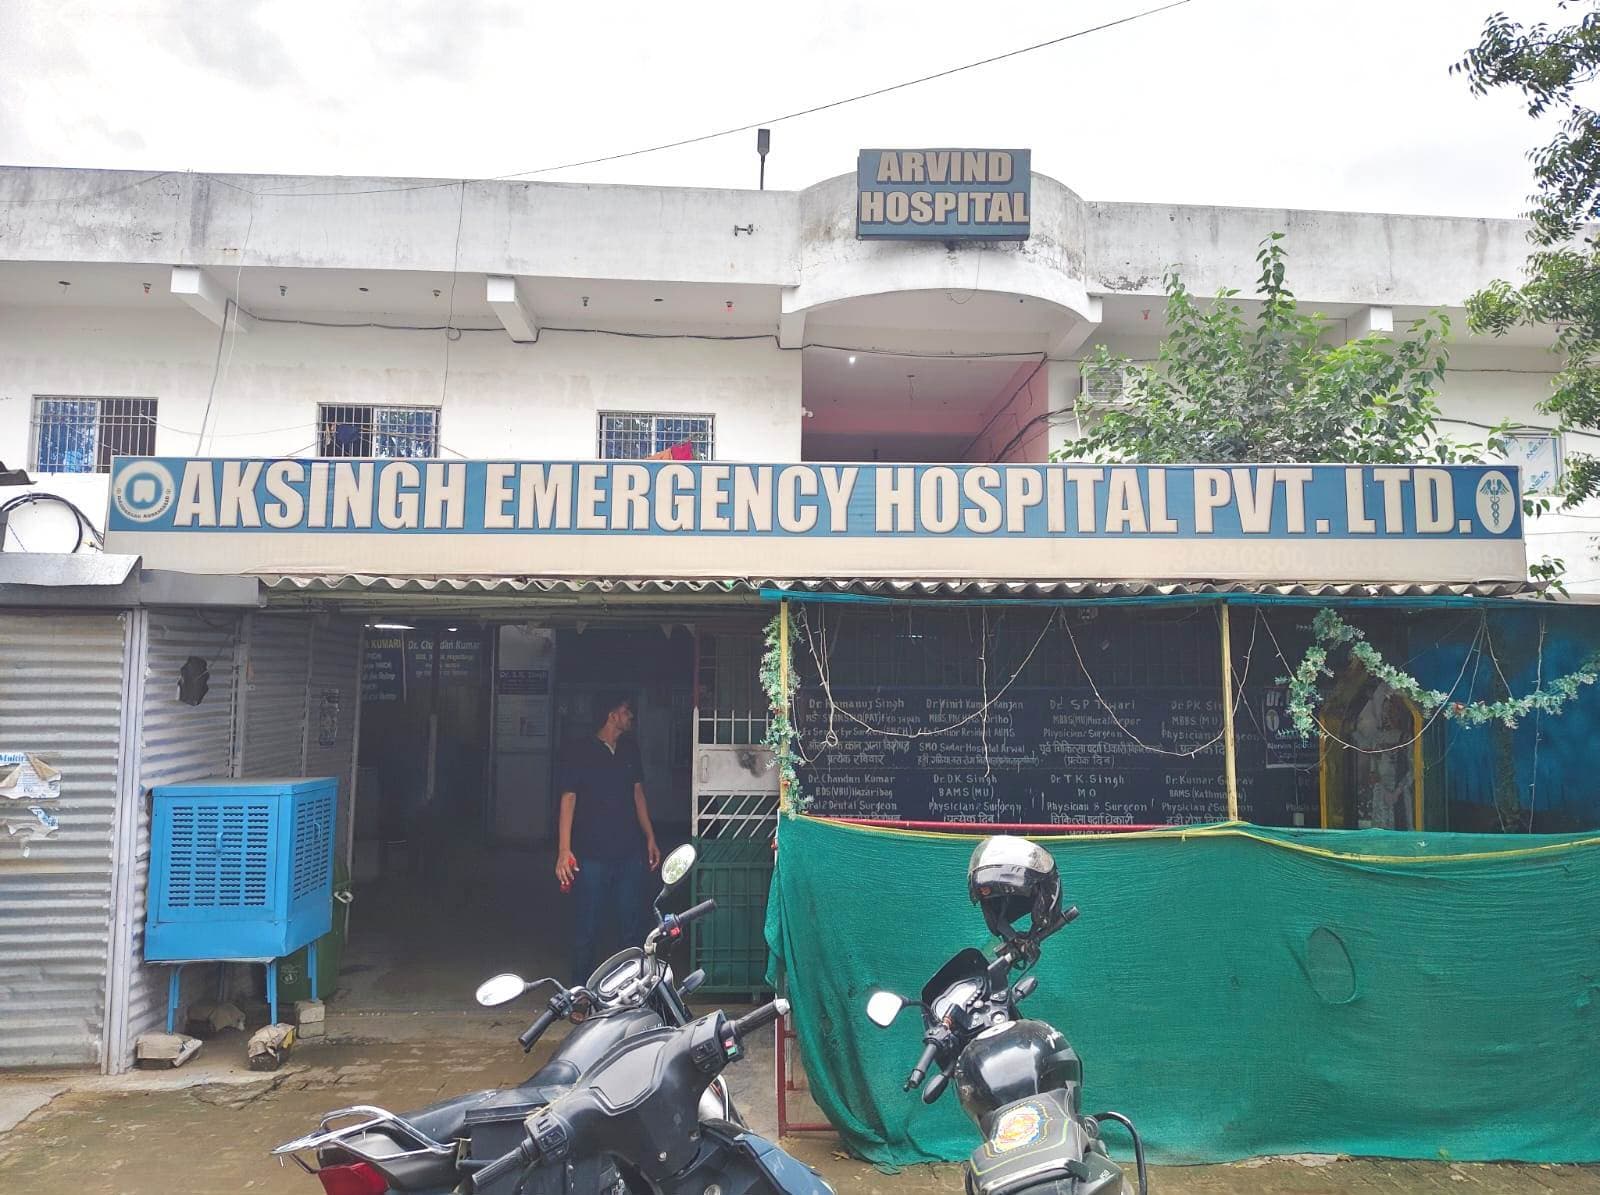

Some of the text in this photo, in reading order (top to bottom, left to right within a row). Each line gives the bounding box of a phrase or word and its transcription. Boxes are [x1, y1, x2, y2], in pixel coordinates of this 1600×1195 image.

[877, 151, 1013, 184] ARVIND
[860, 191, 1030, 225] HOSPITAL
[173, 460, 1472, 534] AKSINGH EMERGENCY HOSPITAL PVT. LTD.
[864, 774, 896, 784] Kumar
[966, 774, 998, 786] Singh
[1089, 774, 1125, 788] Singh
[1104, 801, 1148, 813] Surgeon
